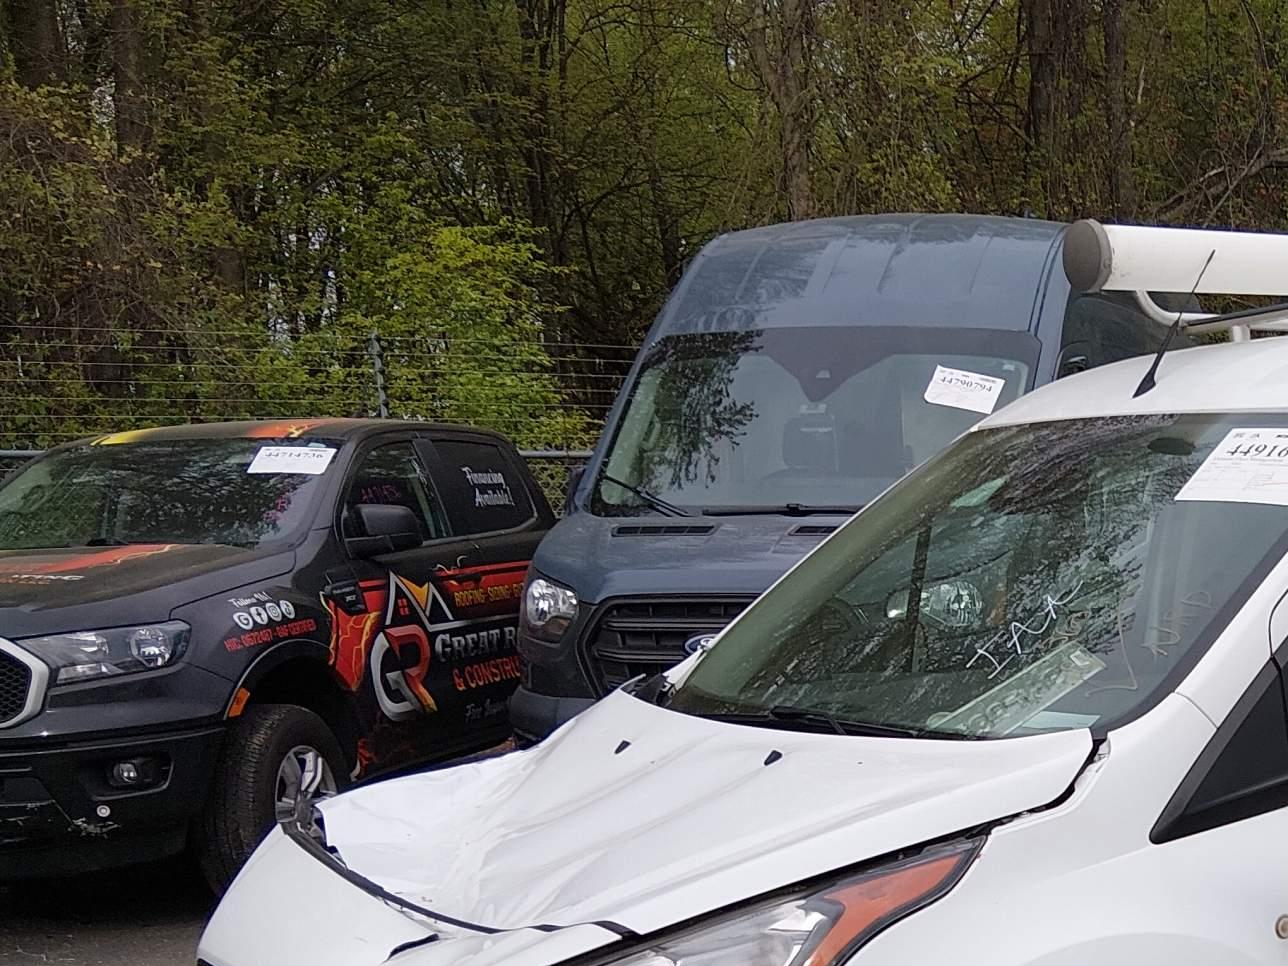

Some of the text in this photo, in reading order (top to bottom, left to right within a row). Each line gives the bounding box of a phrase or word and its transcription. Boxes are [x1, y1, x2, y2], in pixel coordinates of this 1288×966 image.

[460, 466, 505, 489] Financing
[475, 487, 516, 507] Available!
[434, 628, 500, 662] GREAT
[453, 668, 467, 691] &
